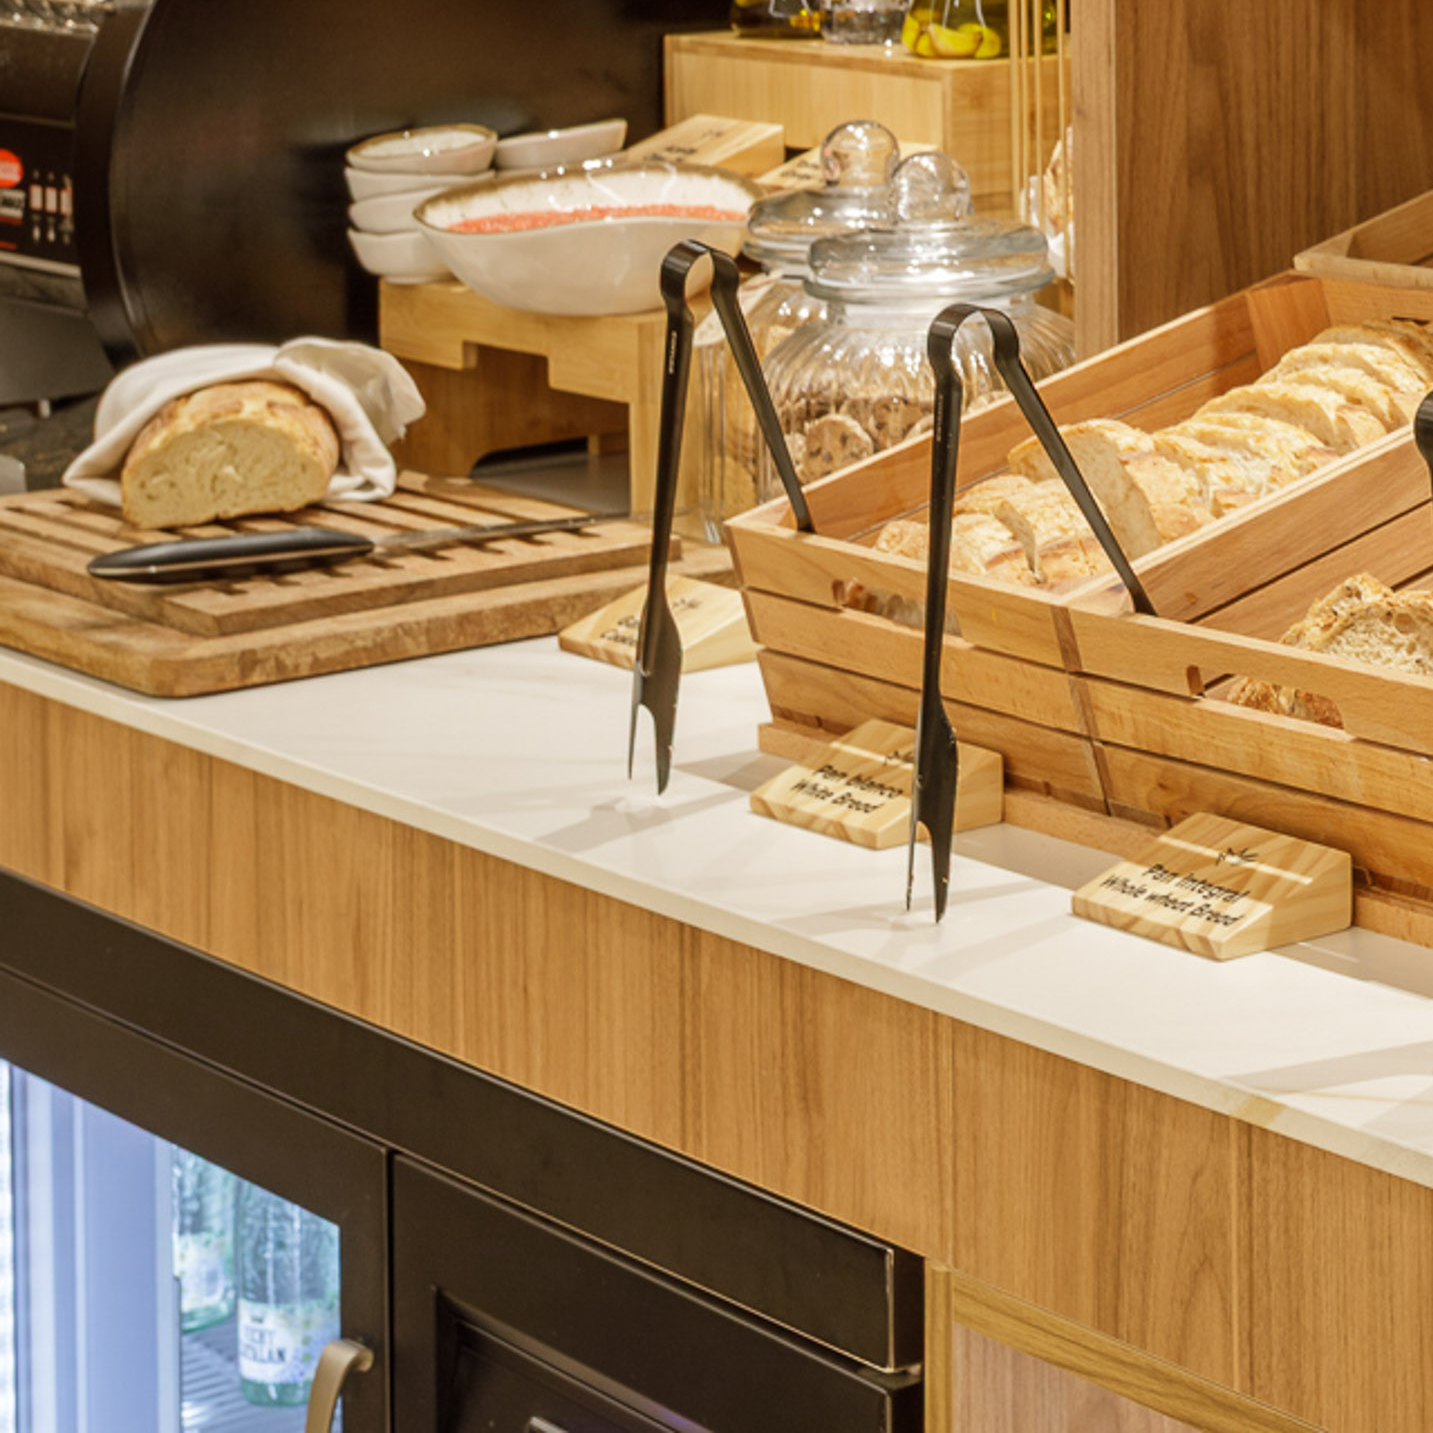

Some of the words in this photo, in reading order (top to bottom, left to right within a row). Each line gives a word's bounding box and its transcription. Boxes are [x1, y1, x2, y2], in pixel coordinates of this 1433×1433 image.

[792, 779, 834, 801] White
[833, 792, 885, 814] Bread
[814, 764, 846, 784] Pan
[845, 772, 904, 799] blanco
[1100, 874, 1148, 898] Whole
[1145, 892, 1195, 913] wheat
[1190, 903, 1245, 927] Bread
[1142, 864, 1180, 882] Pan
[1176, 872, 1250, 903] integral
